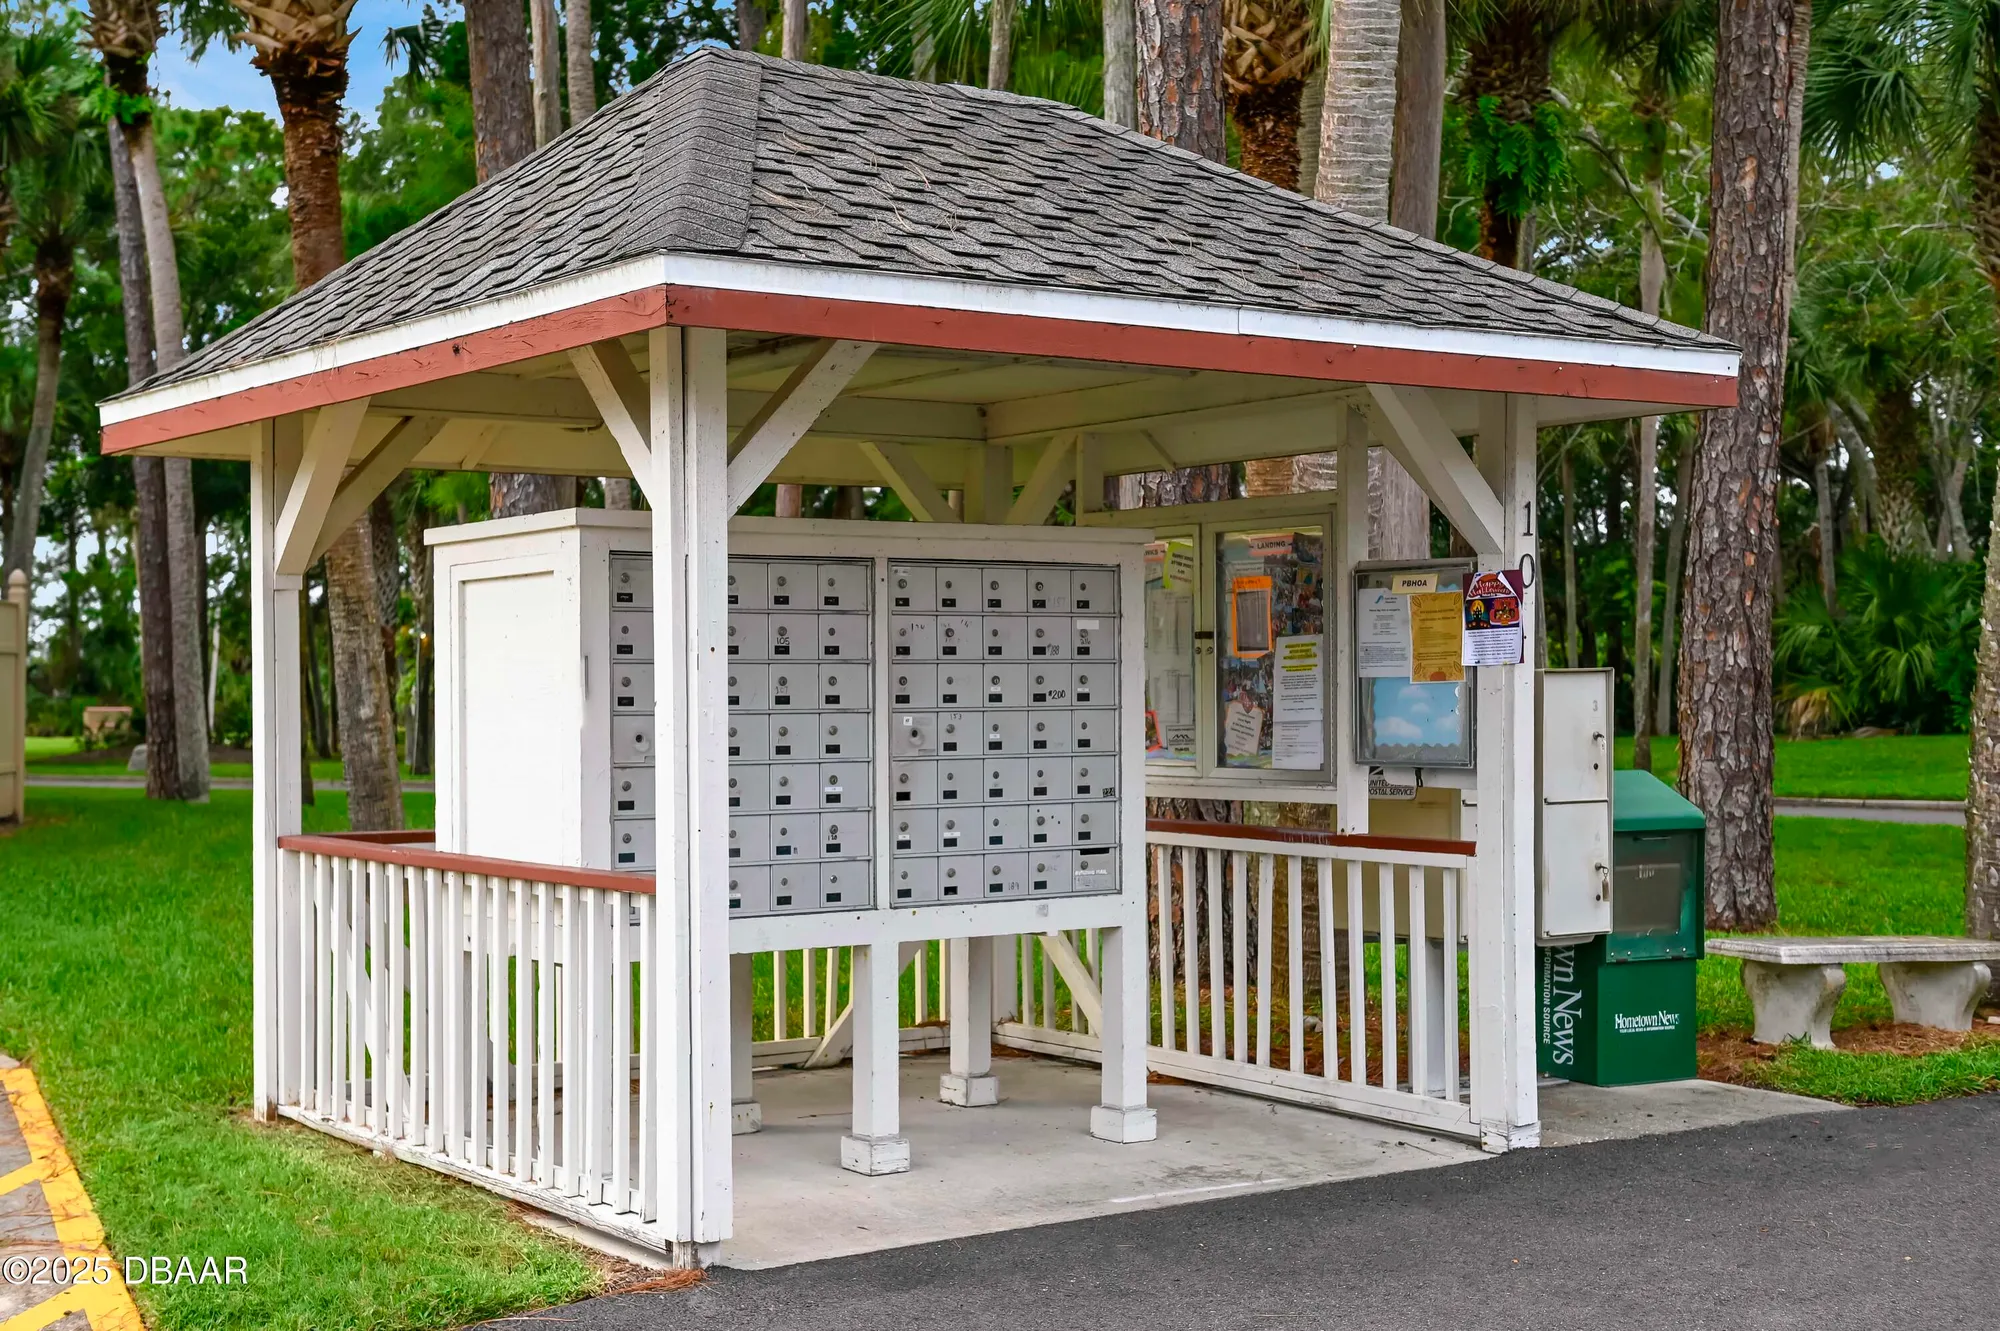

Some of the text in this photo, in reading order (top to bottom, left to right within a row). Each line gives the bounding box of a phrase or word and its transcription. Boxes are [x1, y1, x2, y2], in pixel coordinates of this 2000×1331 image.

[1257, 541, 1286, 549] LANDING
[776, 637, 790, 646] 105
[1389, 788, 1414, 796] SERVICE
[1543, 946, 1552, 1045] NFORMATION SOURCE
[1615, 1010, 1679, 1029] Hometown News
[1552, 989, 1582, 1066] News
